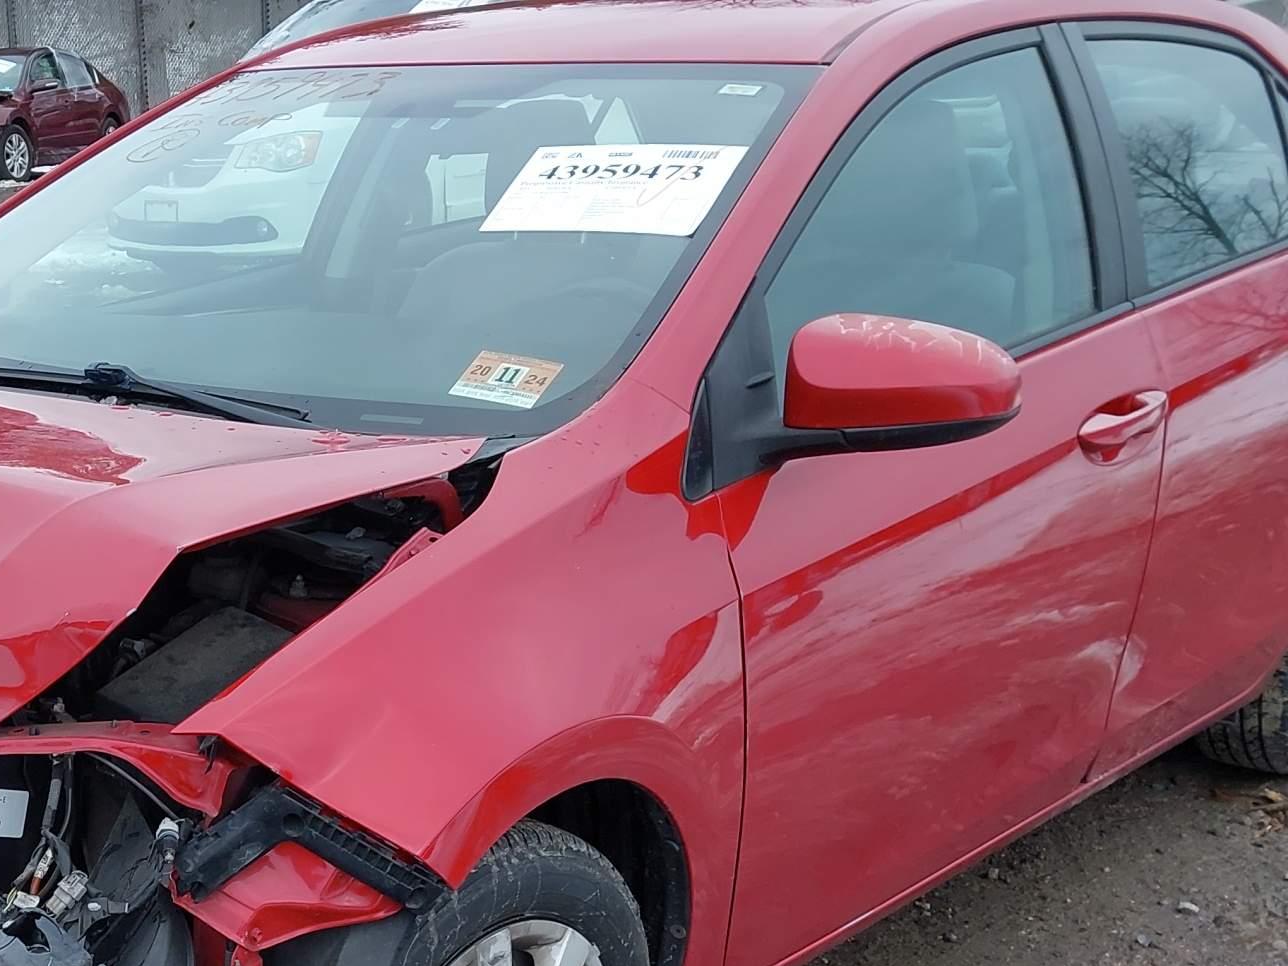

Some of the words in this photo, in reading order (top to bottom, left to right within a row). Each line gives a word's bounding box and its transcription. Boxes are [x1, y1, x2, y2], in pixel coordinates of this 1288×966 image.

[538, 163, 705, 181] 43959473
[471, 364, 492, 377] 20
[495, 366, 521, 384] 11
[524, 374, 548, 387] 24
